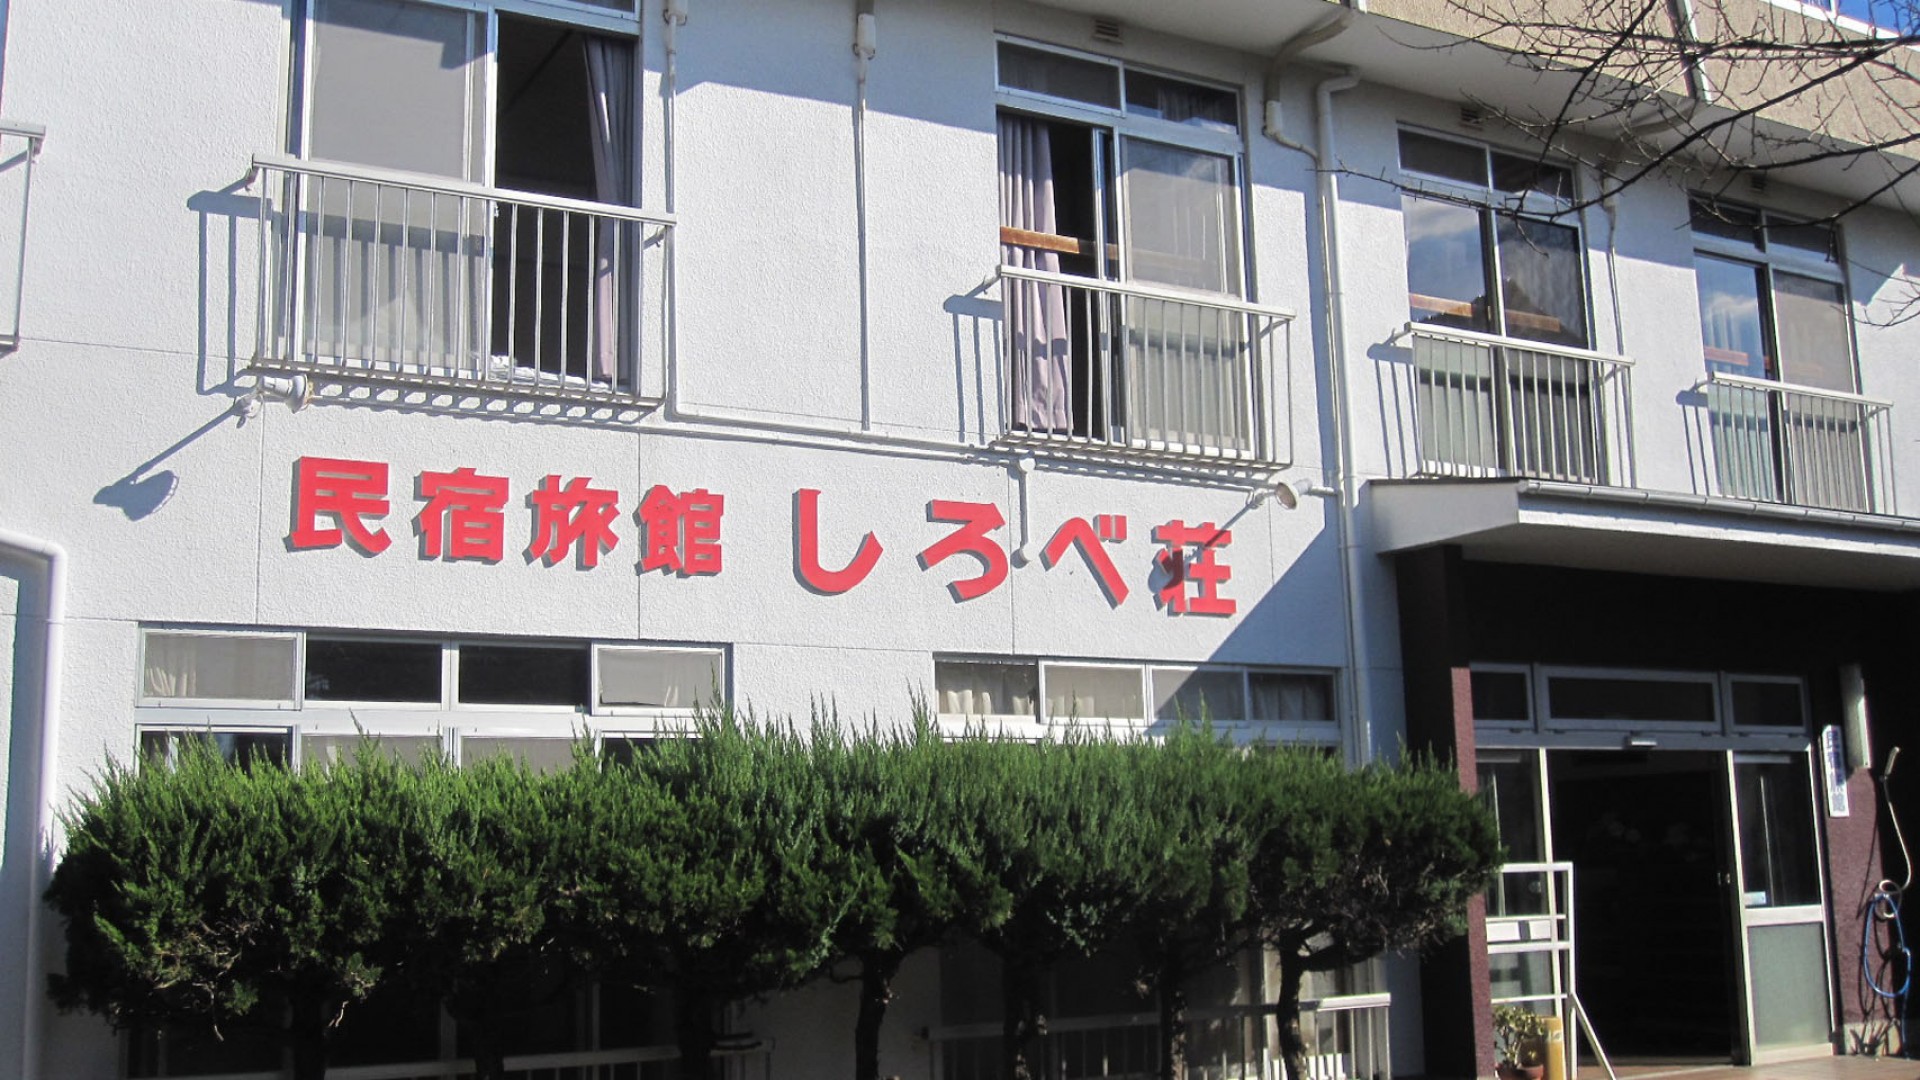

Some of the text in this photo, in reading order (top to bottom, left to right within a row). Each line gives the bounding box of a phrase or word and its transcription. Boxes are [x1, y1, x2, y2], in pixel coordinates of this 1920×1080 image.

[290, 456, 1237, 615] 民宿旅館 しろべ荘
